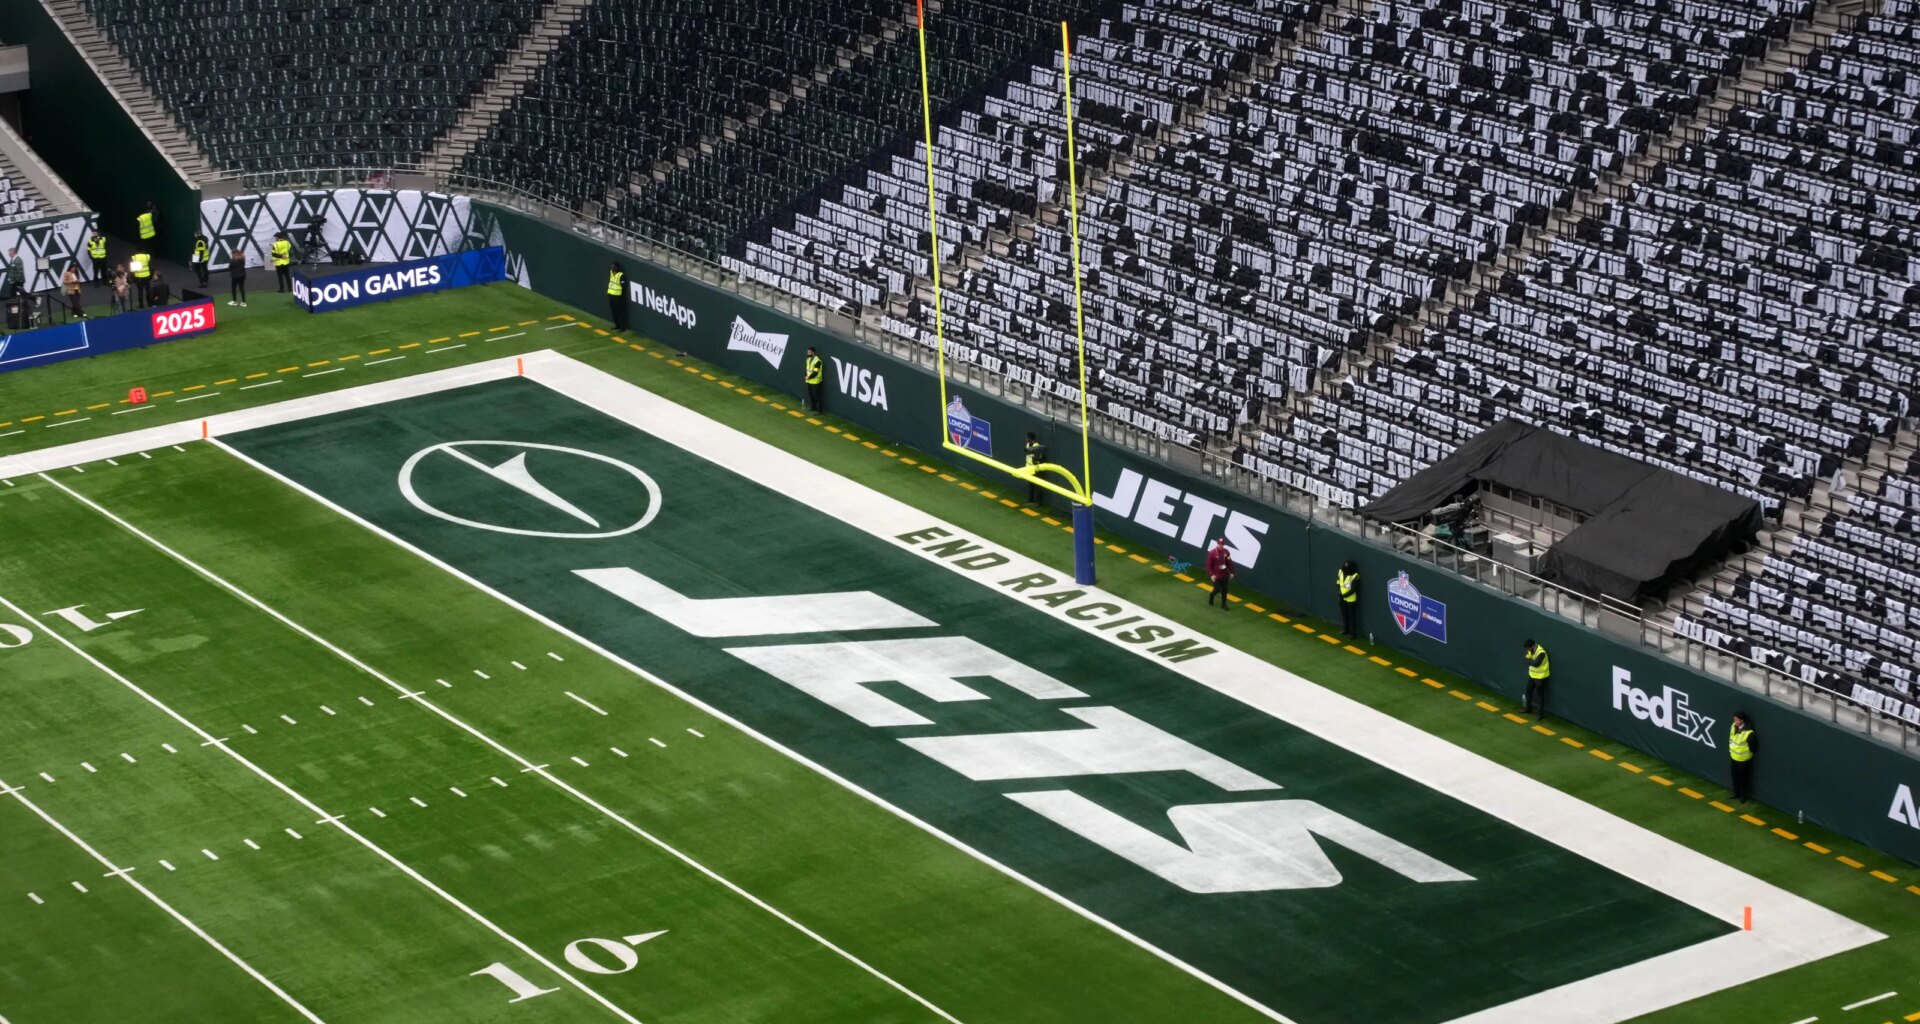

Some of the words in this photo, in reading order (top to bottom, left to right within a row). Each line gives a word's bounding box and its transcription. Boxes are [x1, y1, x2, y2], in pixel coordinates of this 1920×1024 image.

[55, 223, 70, 232] 124
[292, 277, 359, 306] LONDON
[365, 265, 441, 295] GAMES
[645, 286, 696, 329] NetApp
[156, 308, 205, 334] 2025
[731, 321, 785, 357] Budweiser
[831, 356, 888, 411] VISA
[948, 418, 970, 431] LONDON
[1092, 468, 1270, 569] JETS
[895, 527, 1010, 570] END
[998, 572, 1219, 663] RACISM
[1390, 595, 1419, 612] LONDON
[1612, 665, 1717, 748] FedEx
[570, 567, 1478, 893] JETS
[1888, 783, 1920, 830] A
[470, 938, 638, 1003] 10
